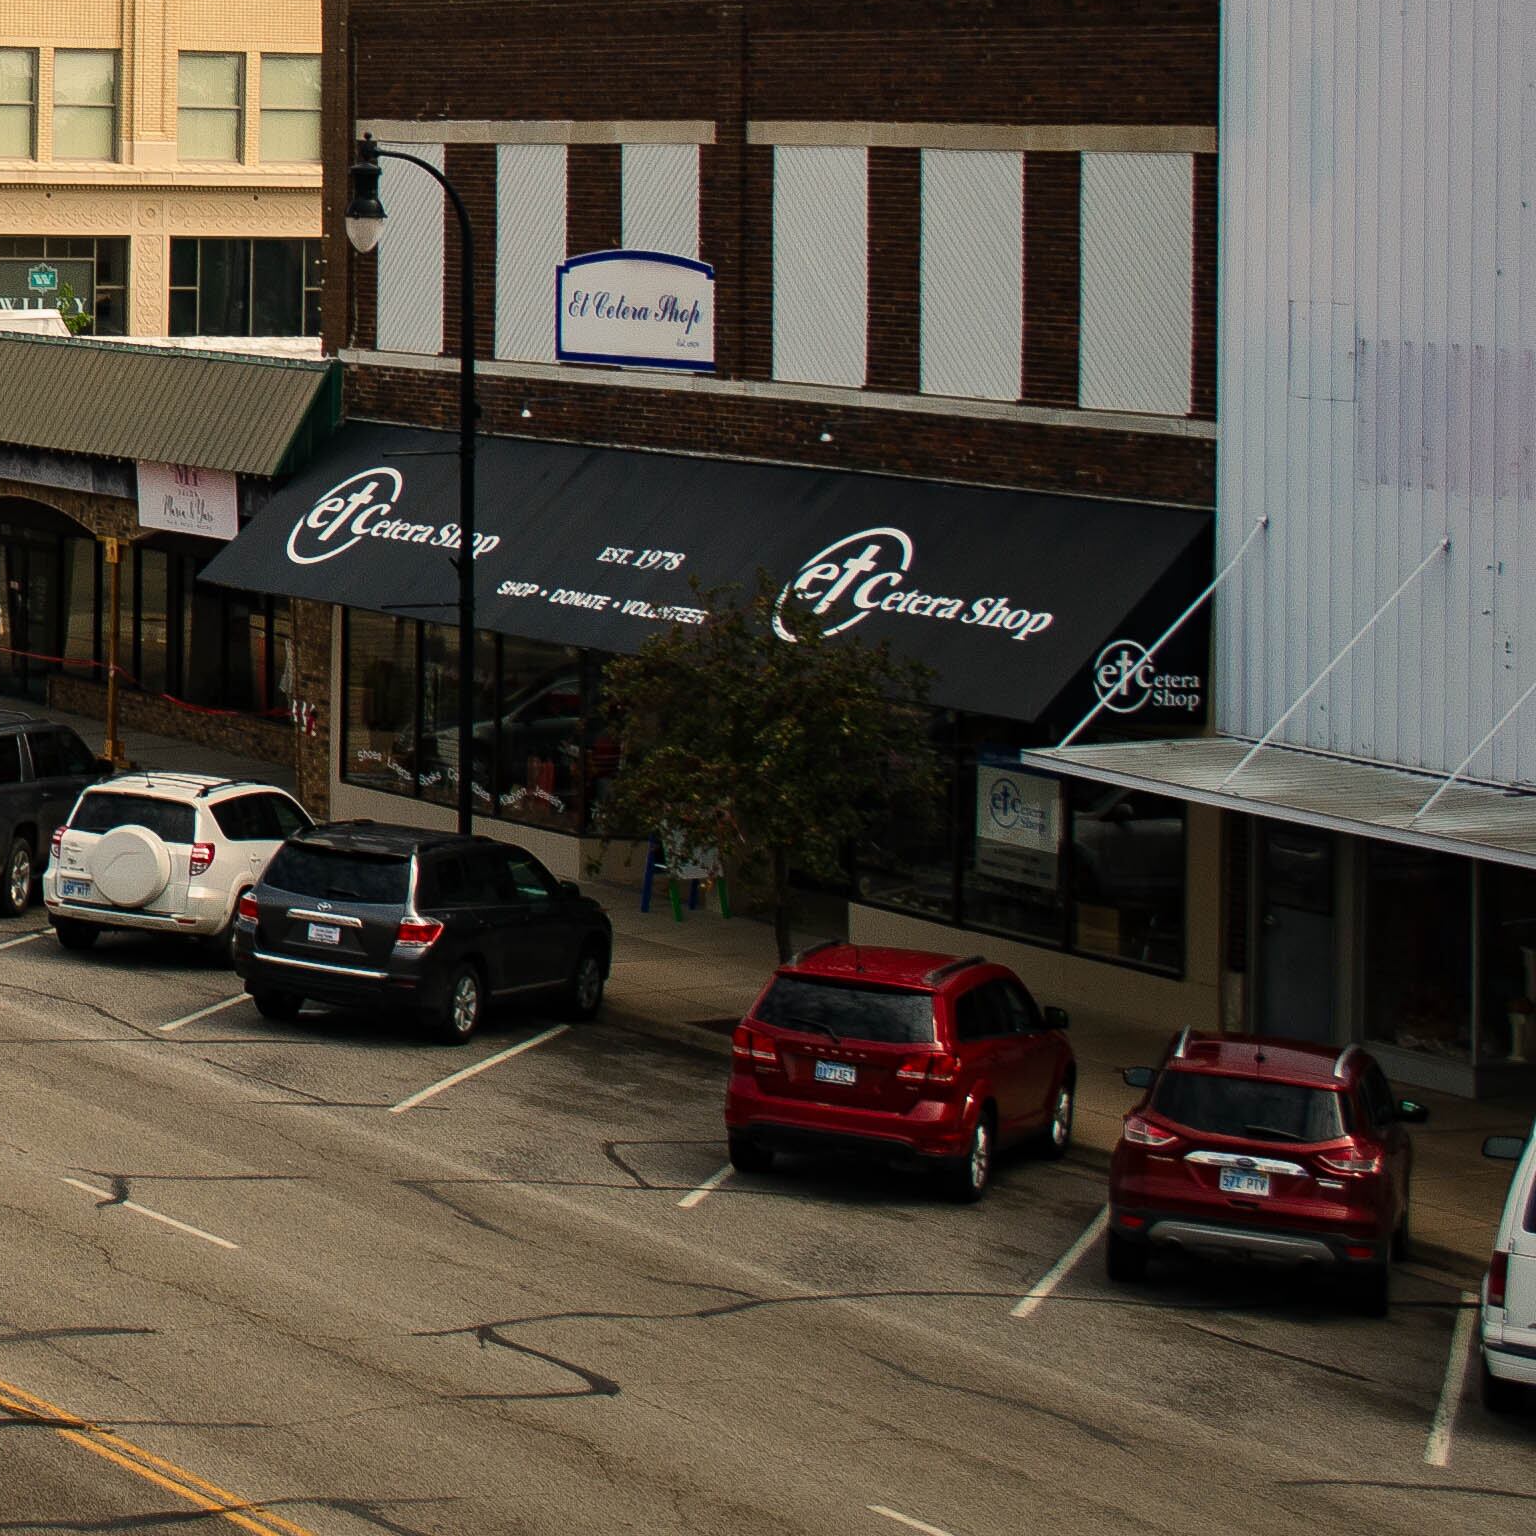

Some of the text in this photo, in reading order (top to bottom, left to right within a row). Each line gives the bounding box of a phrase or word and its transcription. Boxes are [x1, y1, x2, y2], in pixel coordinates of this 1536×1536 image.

[568, 290, 702, 335] Et Cetera Shop
[596, 546, 687, 572] EST. 1978
[496, 579, 540, 597] SHOP
[548, 588, 612, 611] DONATE
[961, 596, 1055, 642] Shop
[1152, 688, 1201, 712] Shop
